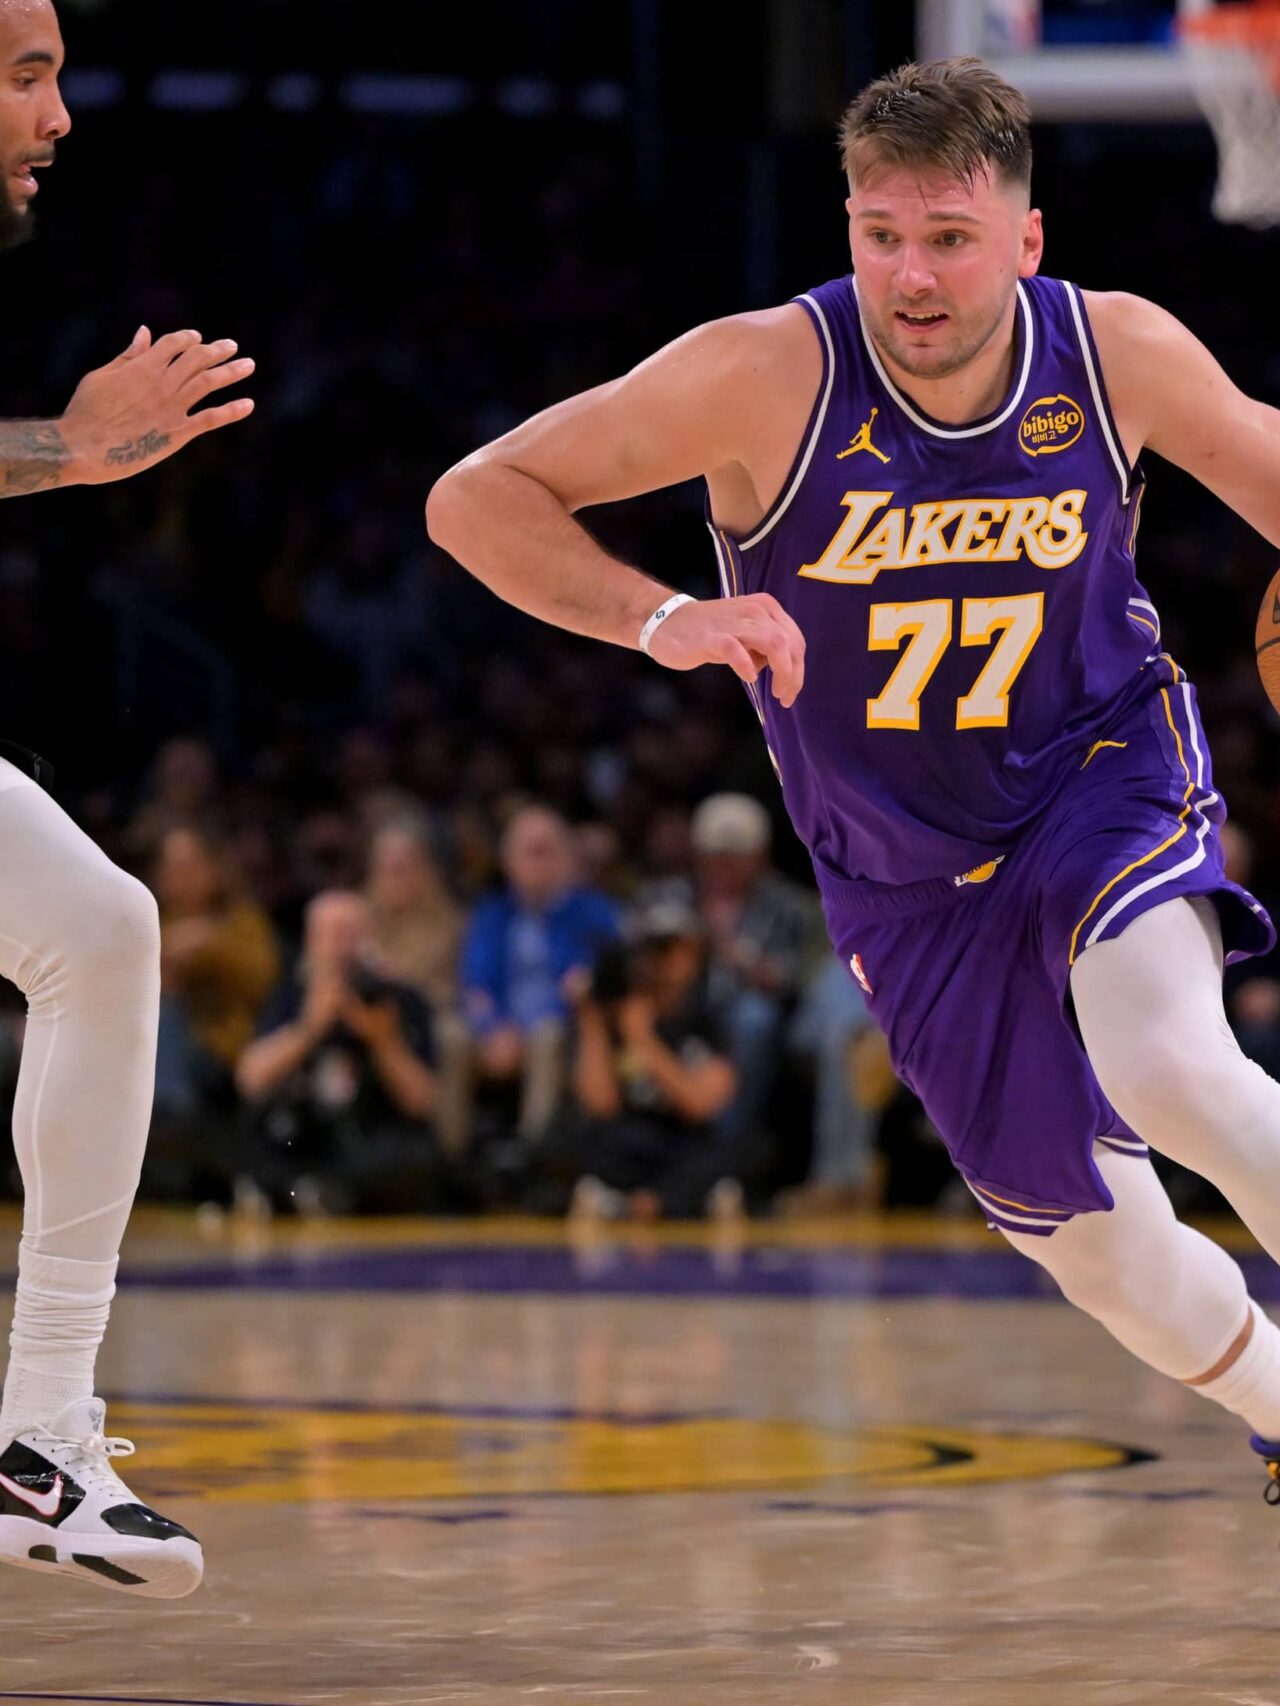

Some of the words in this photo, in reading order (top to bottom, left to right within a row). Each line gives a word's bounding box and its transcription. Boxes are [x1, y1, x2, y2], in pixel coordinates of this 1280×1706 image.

[1023, 411, 1079, 437] bibigo
[1032, 431, 1057, 444] 비비고
[797, 489, 1088, 584] LAKERS
[867, 592, 1044, 730] 77
